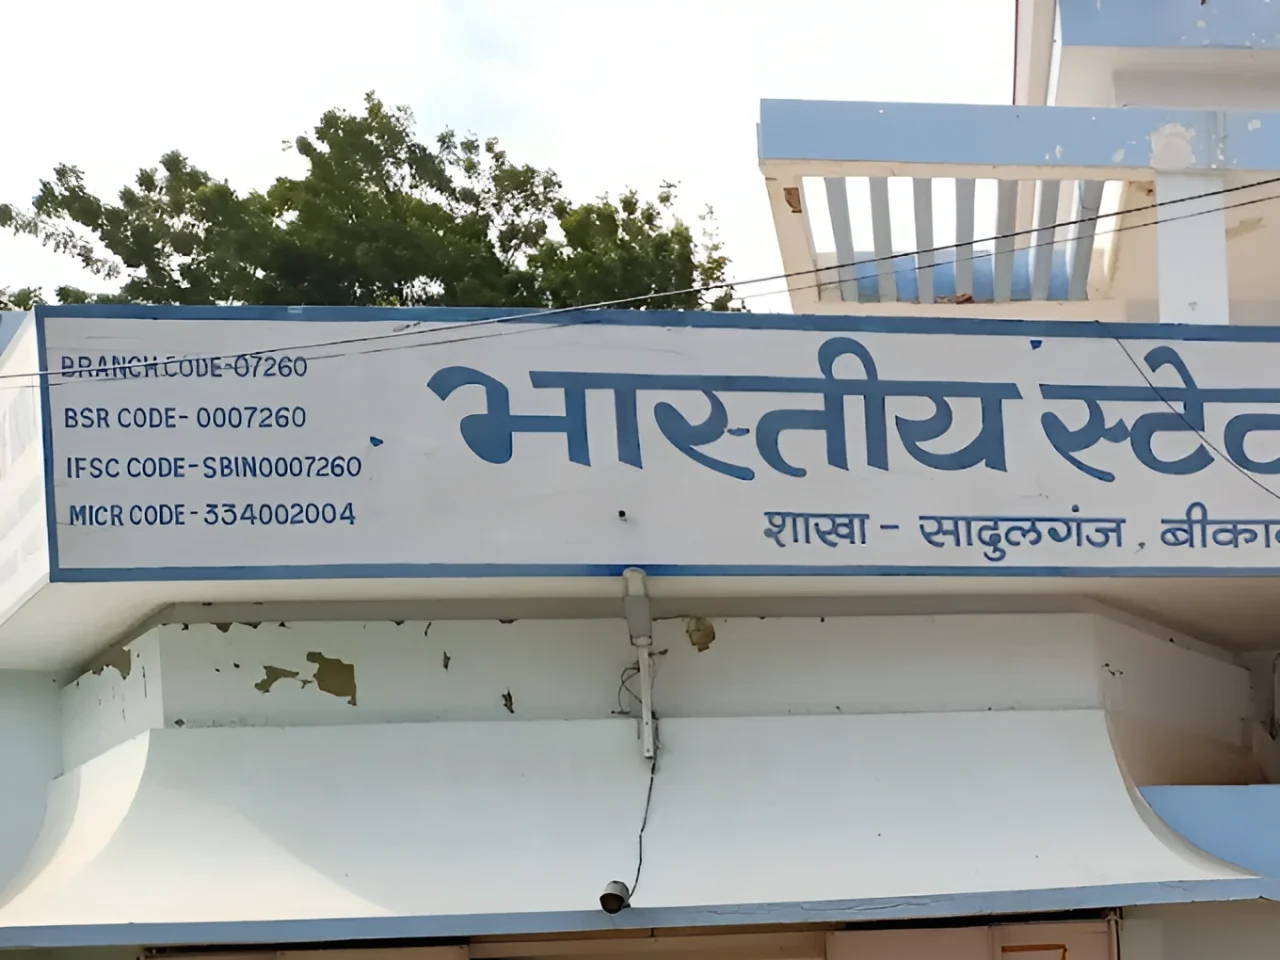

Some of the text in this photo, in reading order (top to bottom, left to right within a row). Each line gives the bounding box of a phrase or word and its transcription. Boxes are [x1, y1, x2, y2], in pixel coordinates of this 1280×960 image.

[61, 355, 159, 378] BRANCH
[64, 407, 111, 428] BSR
[196, 406, 307, 428] 0007260
[427, 336, 1024, 480] भारतीय
[66, 457, 120, 479] IFSC
[69, 504, 125, 526] MICR
[763, 510, 870, 549] शाखा
